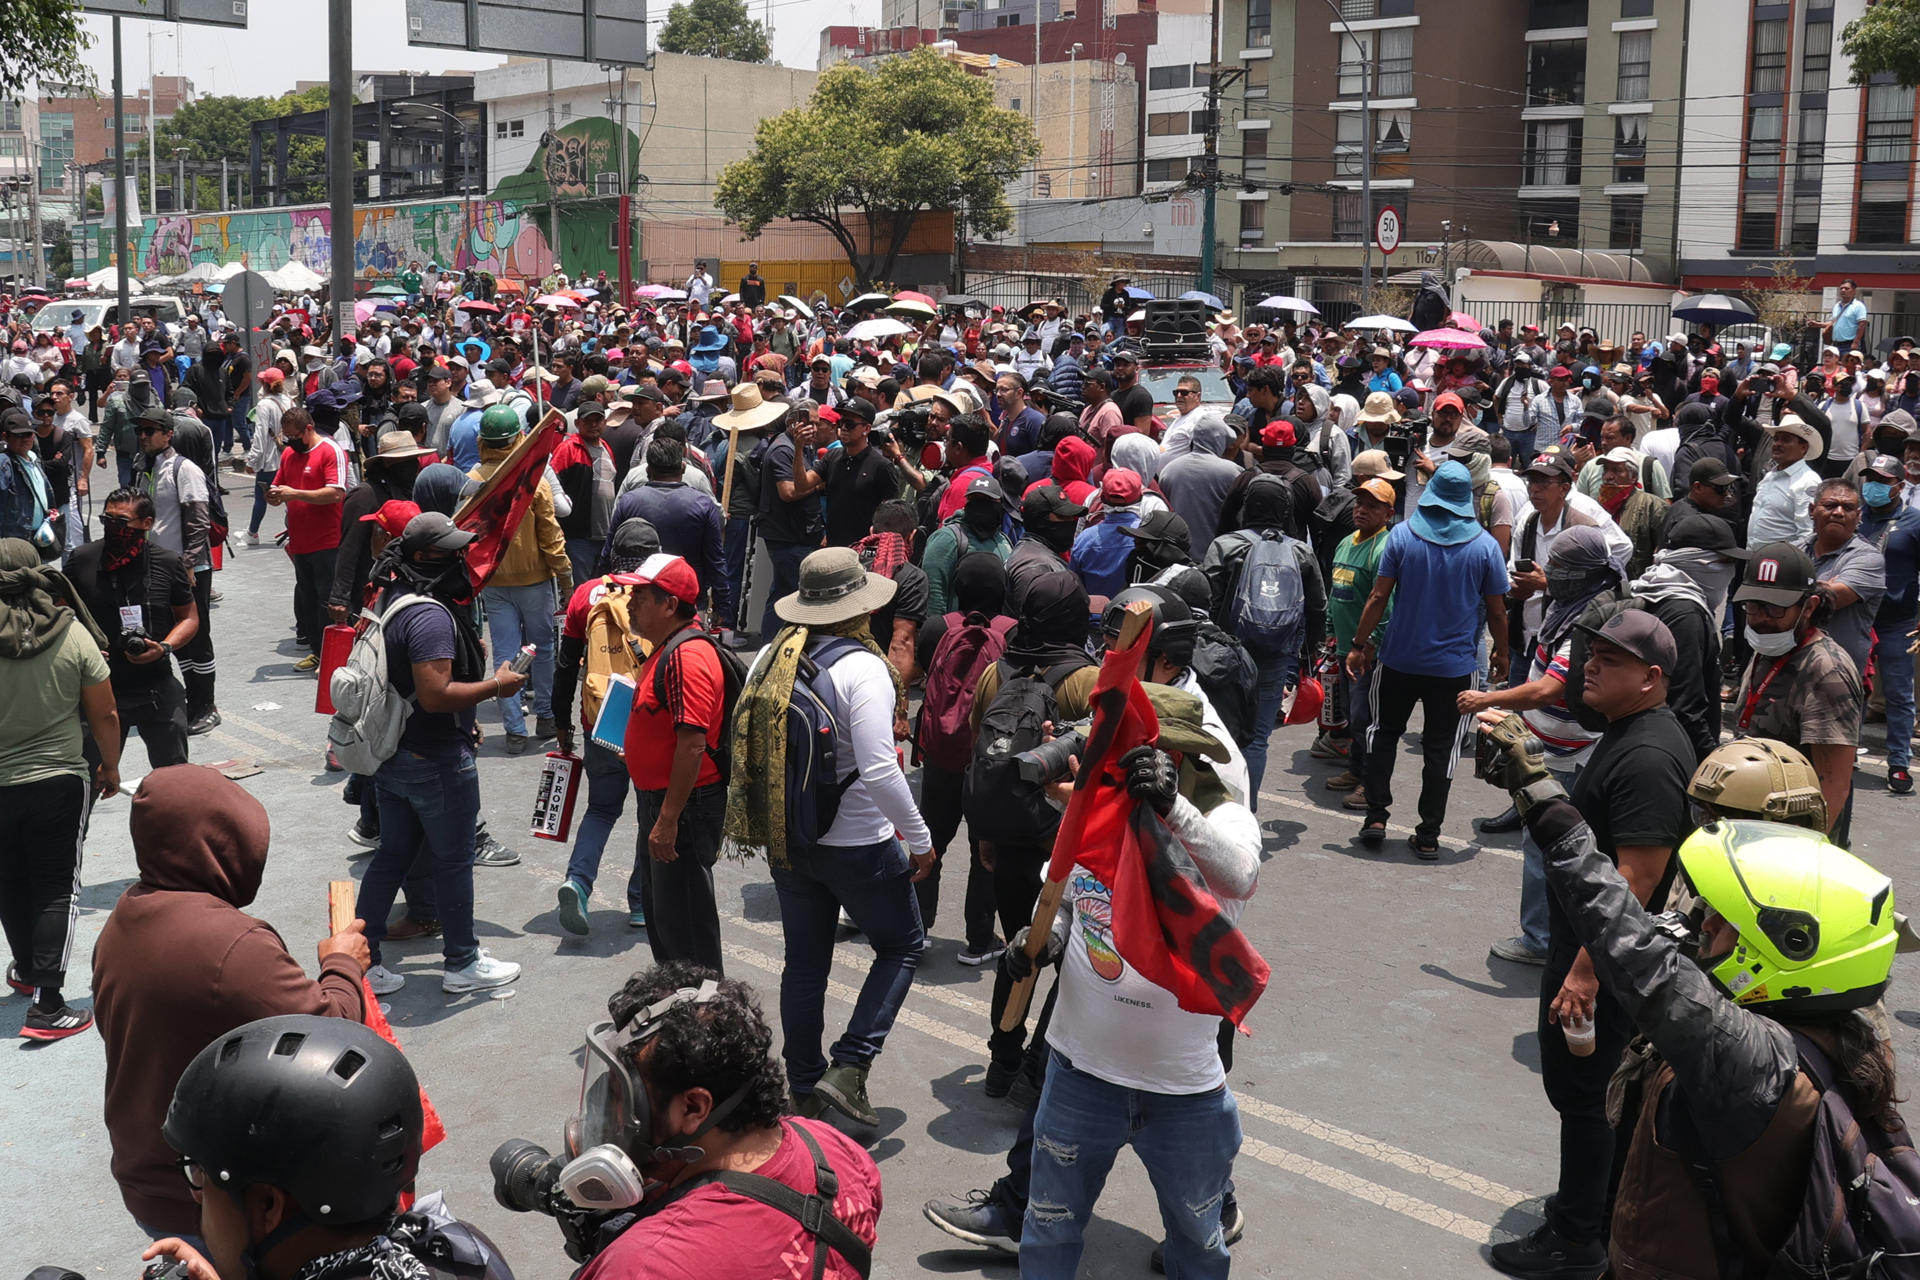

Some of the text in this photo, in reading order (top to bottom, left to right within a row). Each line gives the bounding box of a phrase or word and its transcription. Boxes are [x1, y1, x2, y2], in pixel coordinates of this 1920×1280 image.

[1383, 217, 1395, 232] 50
[1382, 234, 1394, 243] km/h
[546, 775, 565, 831] PROMEX
[1113, 994, 1154, 1009] LIKENESS.
